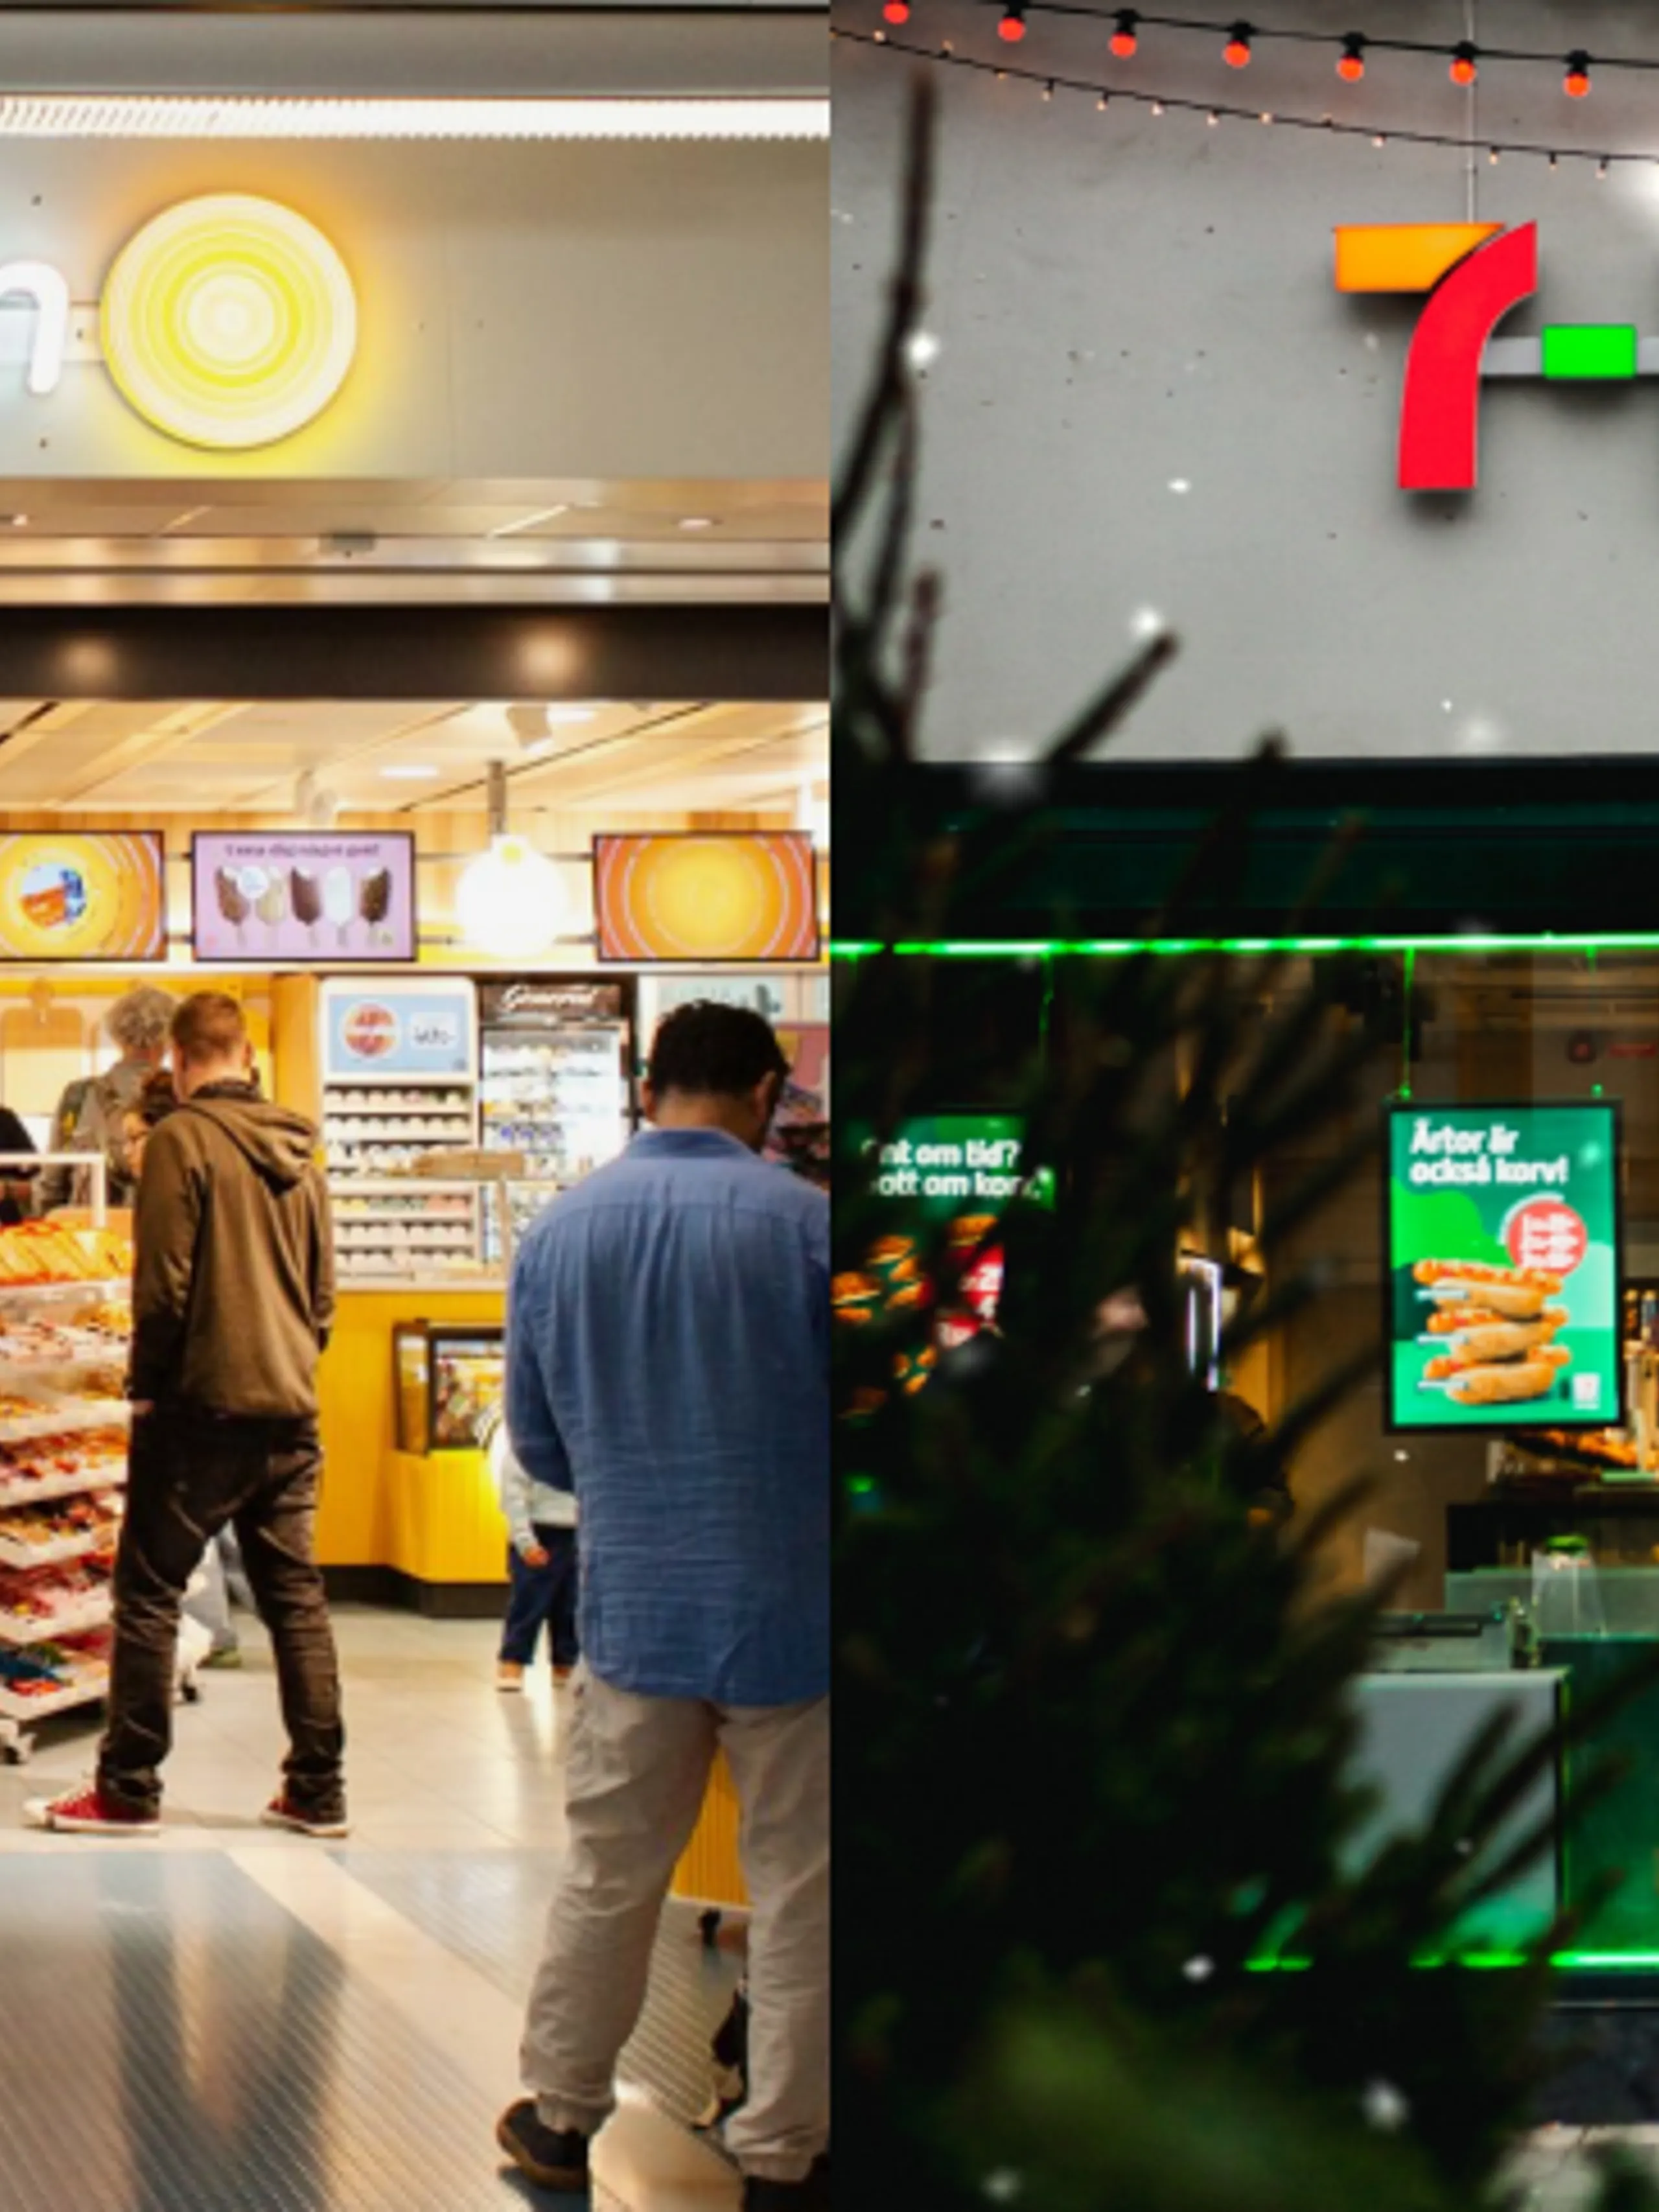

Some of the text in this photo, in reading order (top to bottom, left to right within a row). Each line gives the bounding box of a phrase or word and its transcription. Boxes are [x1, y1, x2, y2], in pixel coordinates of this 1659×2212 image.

[914, 1144, 962, 1166] om
[966, 1139, 1021, 1167] tid?
[1488, 1124, 1520, 1154] är
[872, 1169, 918, 1196] ott
[923, 1174, 970, 1196] om
[1410, 1154, 1569, 1184] också korv!
